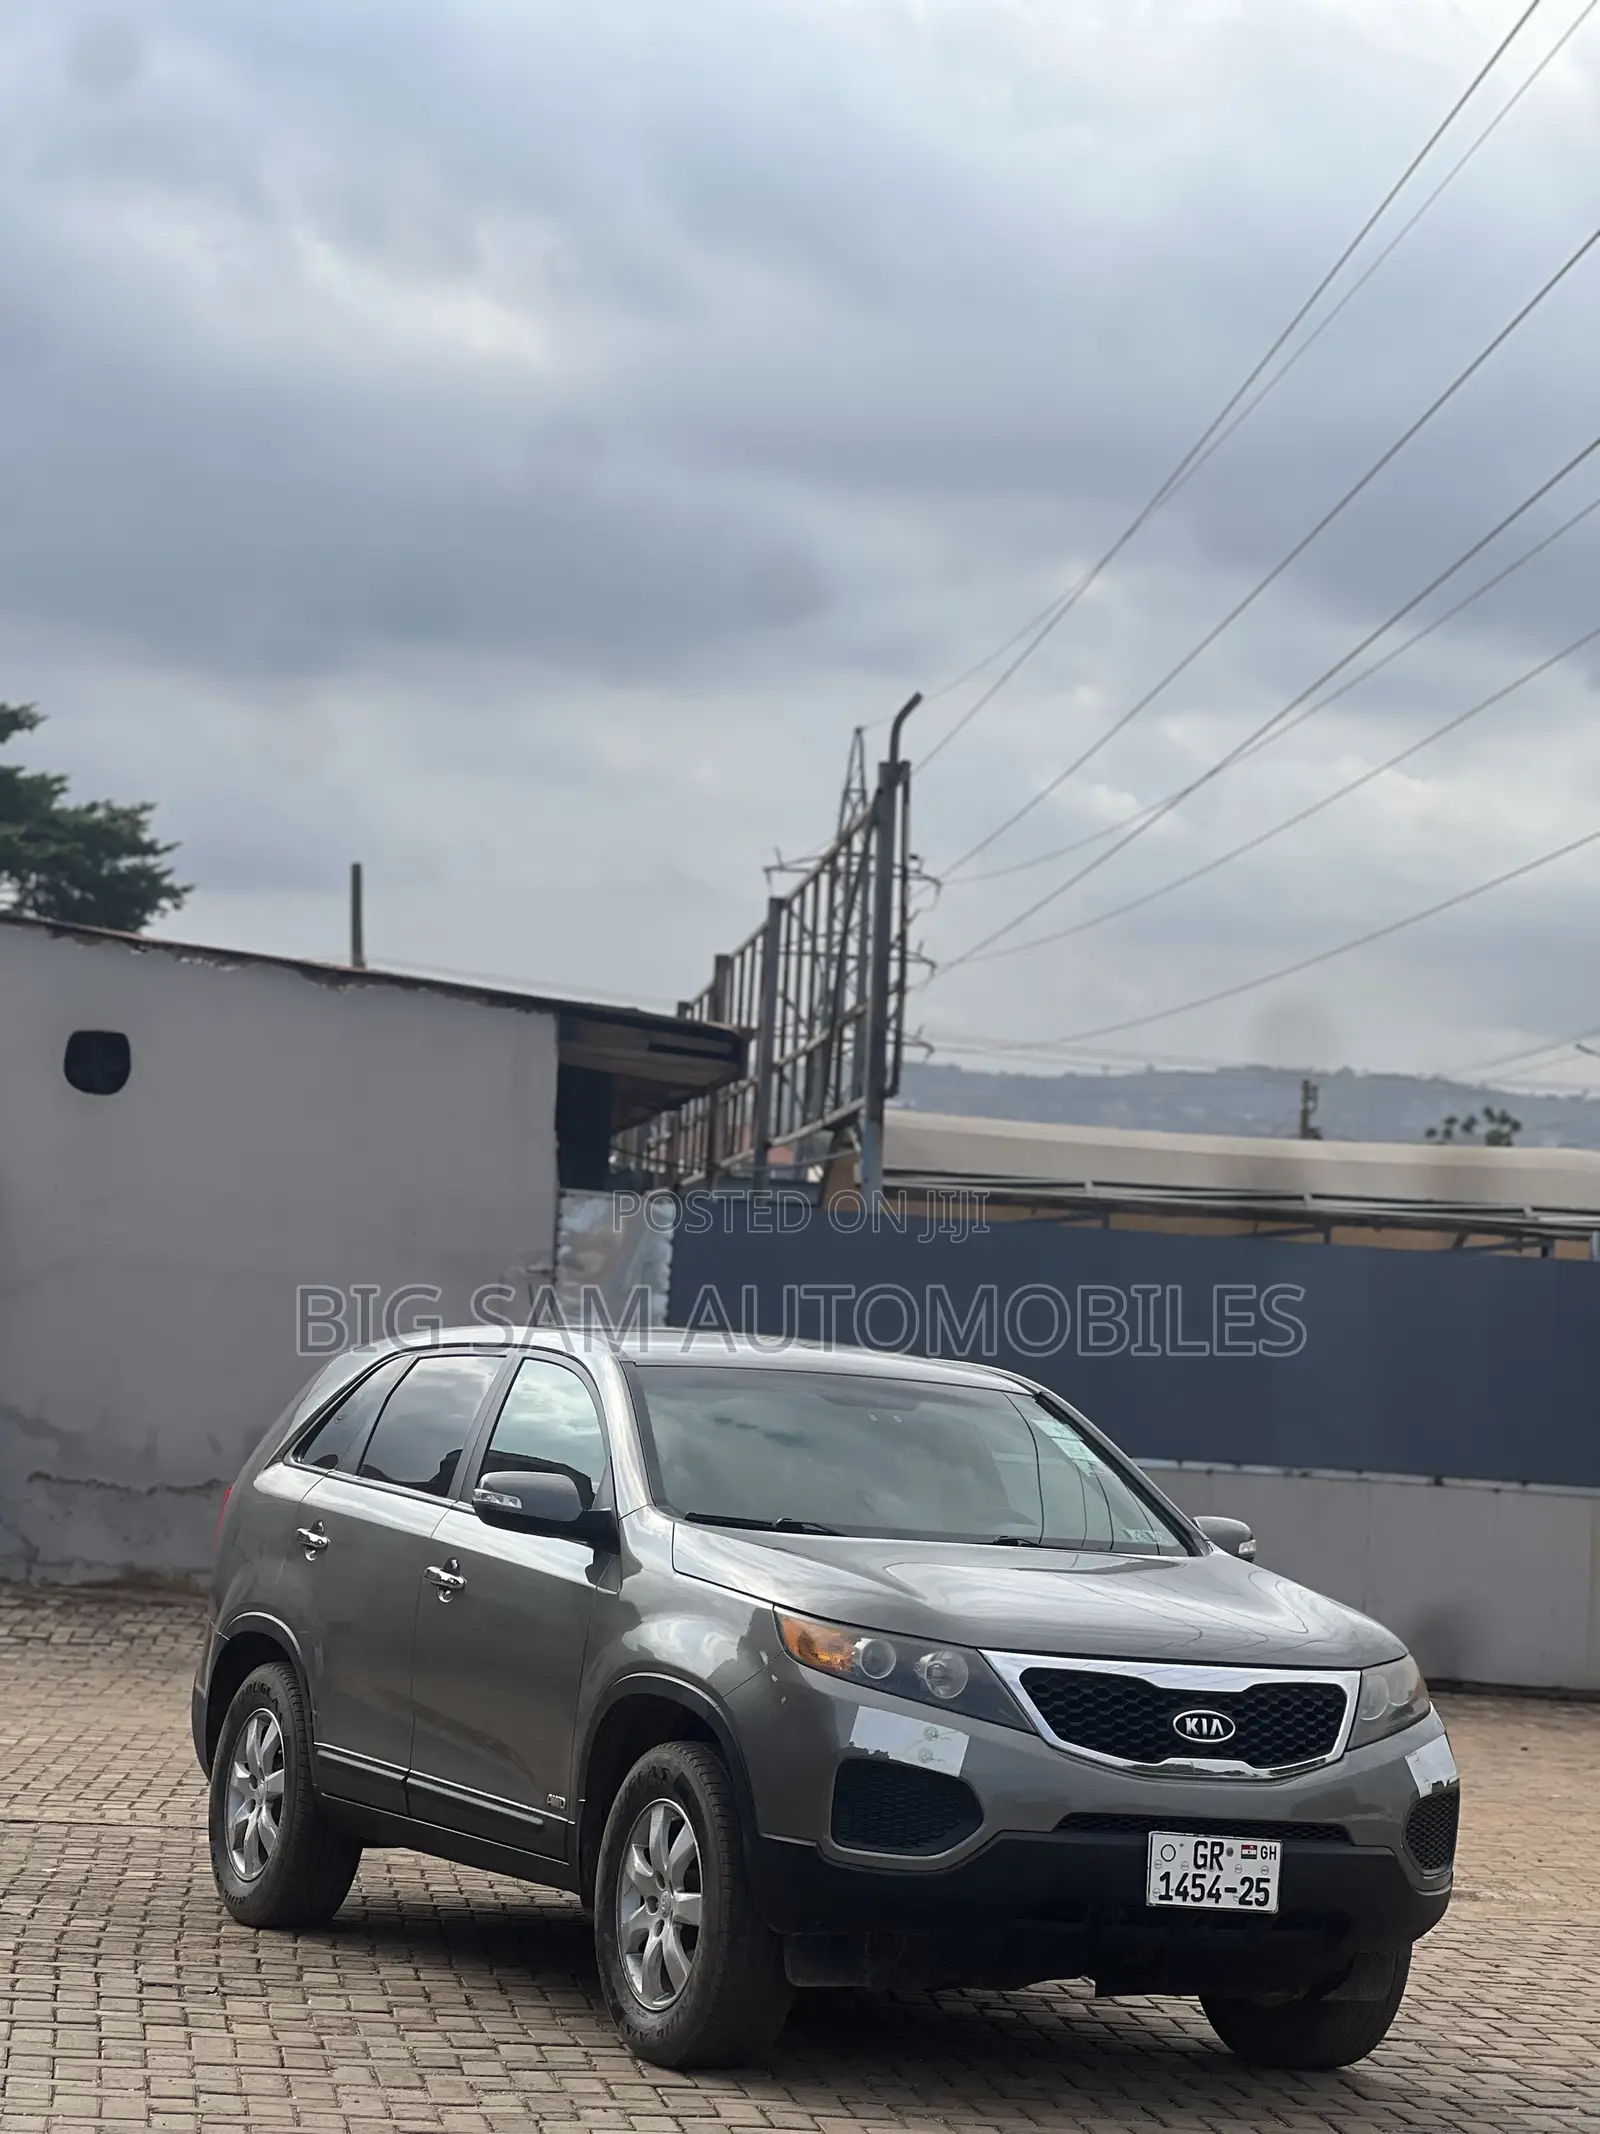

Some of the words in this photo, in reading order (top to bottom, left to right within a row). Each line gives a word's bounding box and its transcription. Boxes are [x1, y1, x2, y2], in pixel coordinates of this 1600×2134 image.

[1184, 1716, 1226, 1737] KIA
[1193, 1839, 1225, 1871] GR
[1260, 1845, 1277, 1861] GH
[1158, 1870, 1271, 1907] 1454-25
